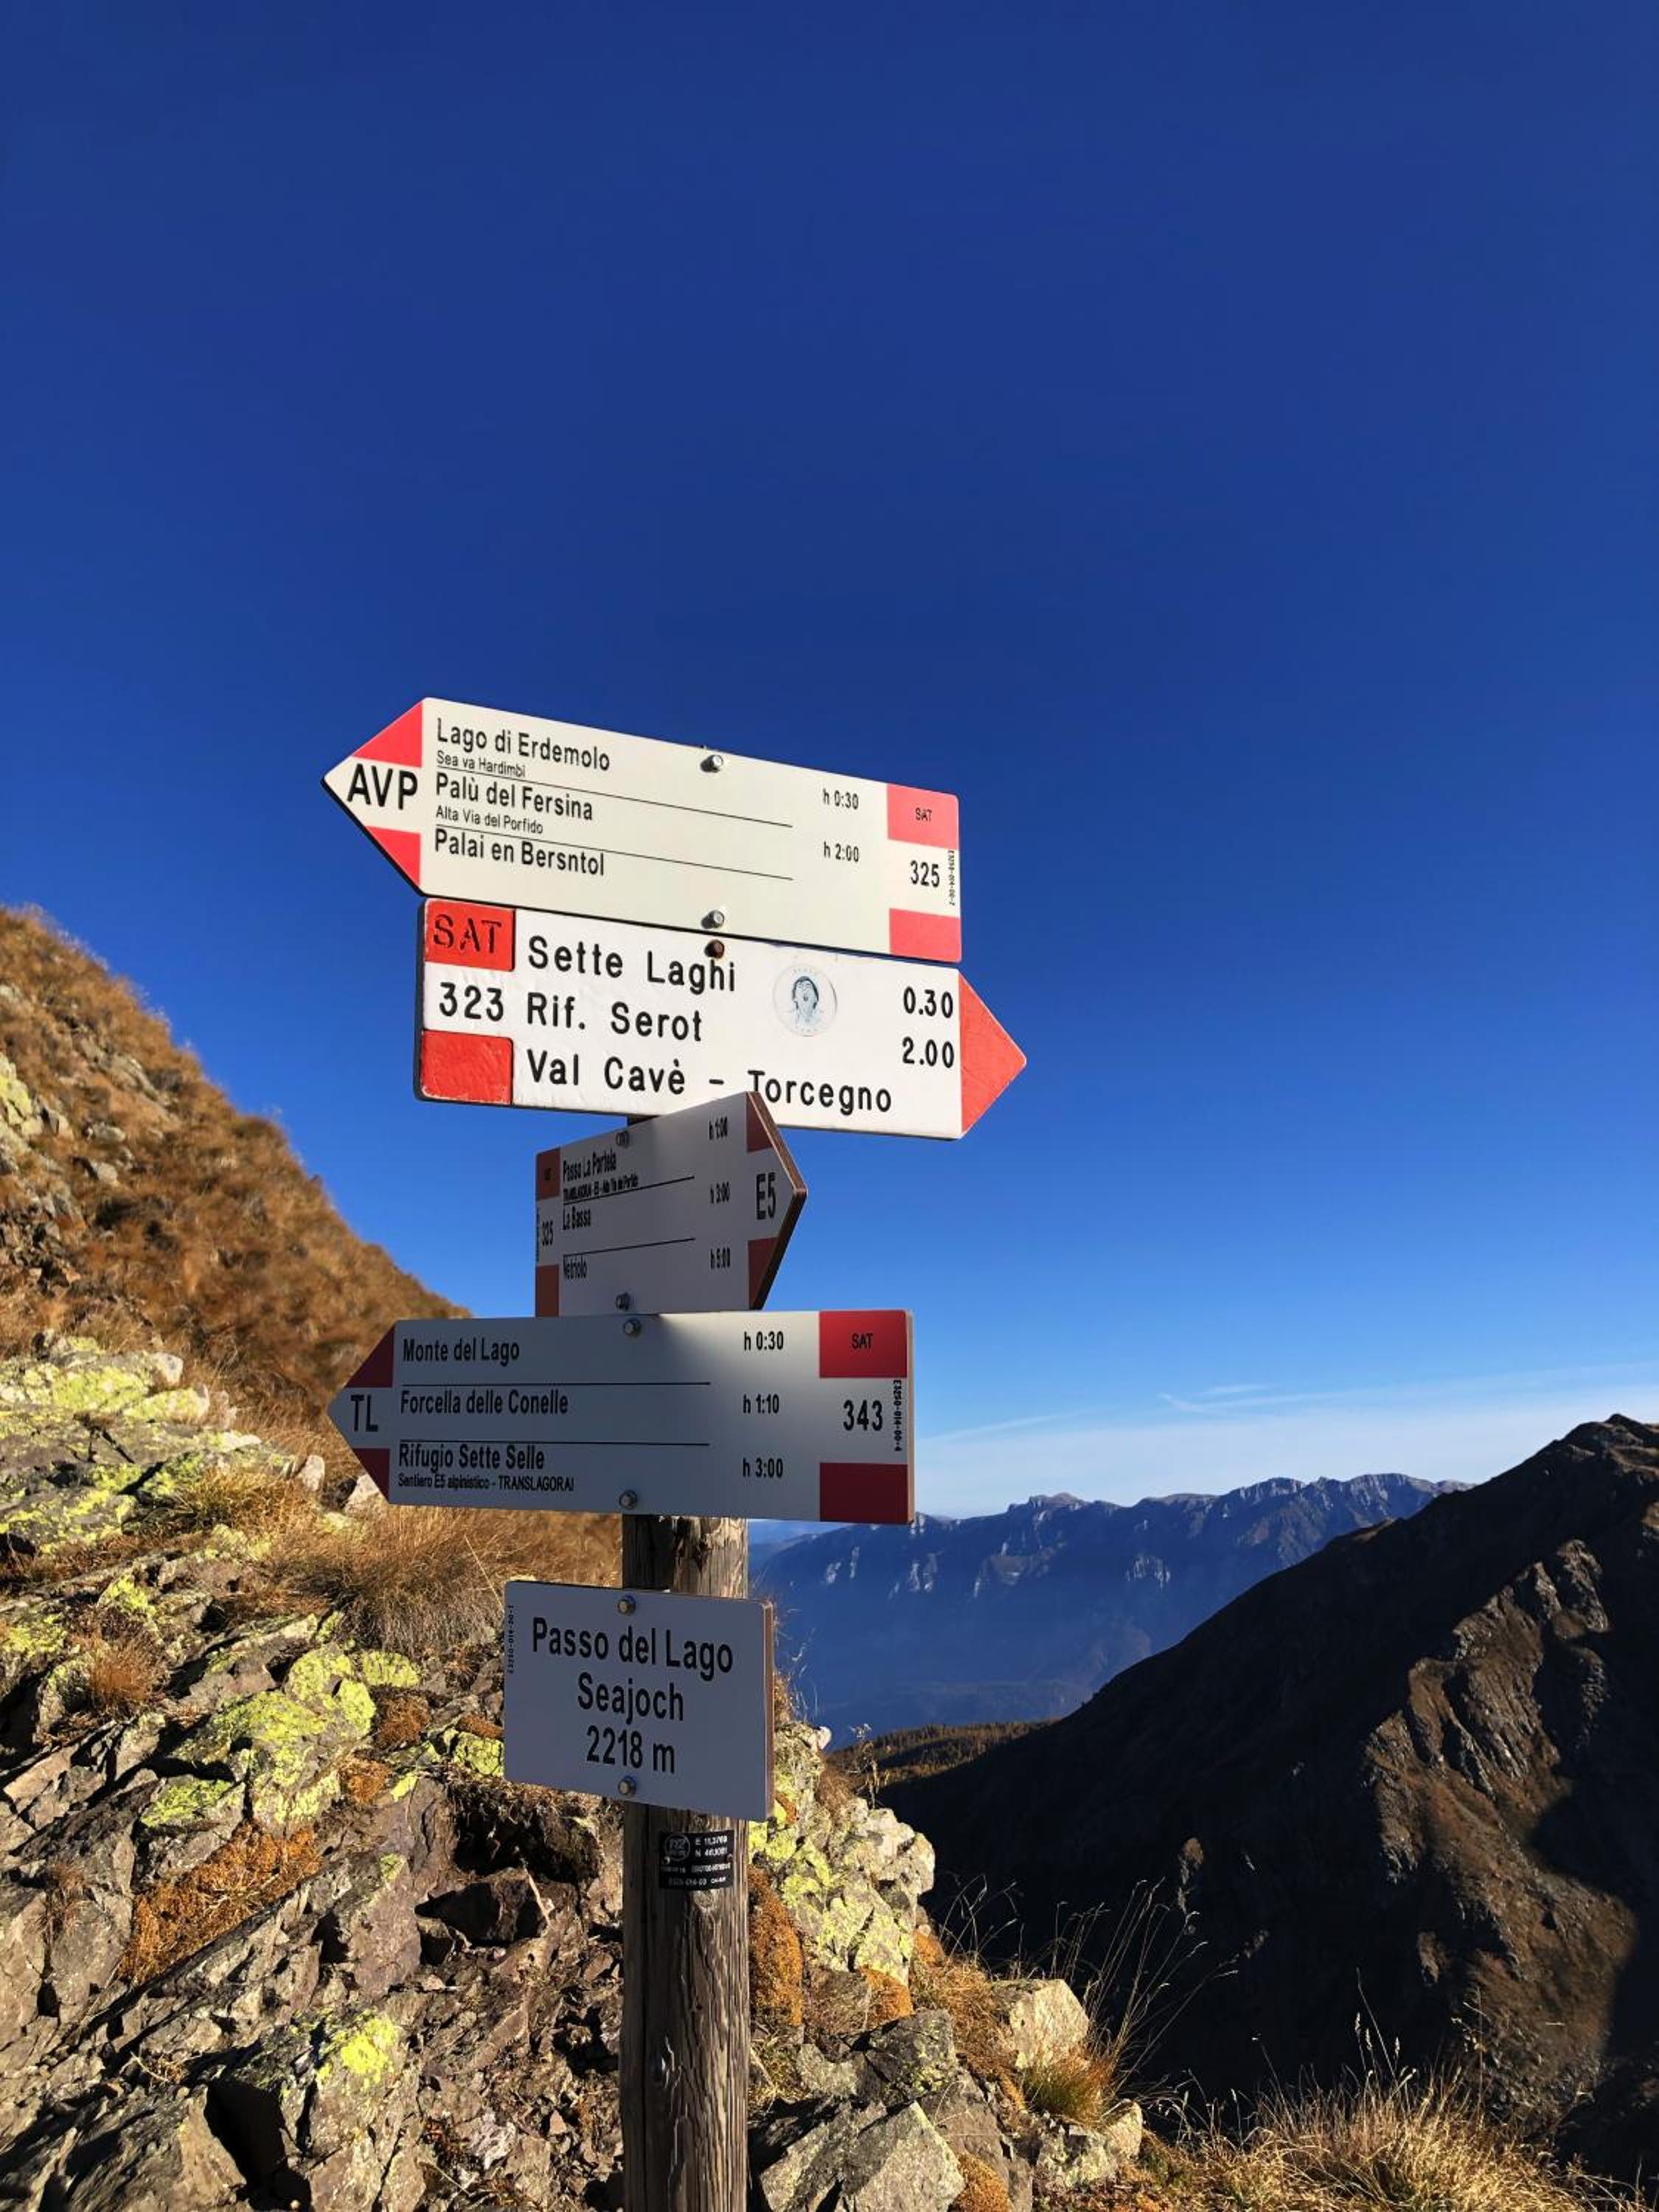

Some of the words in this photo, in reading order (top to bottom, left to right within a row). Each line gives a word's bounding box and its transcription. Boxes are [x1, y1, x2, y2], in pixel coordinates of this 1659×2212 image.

[437, 717, 487, 753] Lago
[495, 729, 511, 754] di
[518, 733, 610, 771] Erdemolo
[437, 751, 458, 767] Sea
[462, 757, 475, 769] va
[479, 758, 526, 777] Hardimbi
[347, 763, 417, 810] AVP
[436, 772, 479, 802] Palù
[487, 784, 515, 807] del
[522, 787, 593, 820] Fersina
[823, 788, 830, 804] h
[834, 790, 859, 810] 0:30
[436, 805, 459, 822] Alta
[462, 809, 481, 825] Via
[484, 813, 501, 827] del
[504, 815, 543, 834] Porfido
[915, 808, 932, 822] SAT
[435, 829, 484, 858] Palai
[492, 841, 515, 863] en
[522, 841, 605, 876] Bersntol
[824, 841, 830, 858] h
[835, 844, 859, 863] 2:00
[911, 860, 939, 887] 325
[433, 914, 501, 955] SAT
[529, 936, 623, 978] Sette
[647, 950, 736, 995] Laghi
[439, 981, 504, 1022] 323
[528, 992, 586, 1030] Rif.
[611, 1001, 702, 1041] Serot
[903, 987, 953, 1018] 0.30
[902, 1037, 954, 1068] 2.00
[526, 1048, 579, 1085] Val
[605, 1056, 686, 1094] Cavè
[748, 1070, 891, 1116] Torcegno
[563, 1158, 582, 1181] Passo
[756, 1172, 776, 1220] E5
[563, 1208, 571, 1231] La
[572, 1207, 591, 1228] Bassa
[403, 1338, 448, 1362] Monte
[453, 1338, 476, 1361] del
[481, 1339, 520, 1366] Lago
[744, 1332, 751, 1351] h
[756, 1331, 784, 1351] 0:30
[852, 1333, 873, 1350] SAT
[350, 1395, 378, 1433] TL
[400, 1389, 461, 1414] Forcella
[466, 1389, 503, 1414] delle
[509, 1389, 568, 1414] Conelle
[743, 1395, 751, 1414] h
[756, 1394, 779, 1414] 1:10
[843, 1399, 883, 1432] 343
[399, 1443, 453, 1473] Rifugio
[459, 1444, 501, 1469] Sette
[506, 1445, 544, 1470] Selle
[742, 1458, 751, 1478] h
[755, 1458, 784, 1478] 3:00
[398, 1472, 433, 1489] Sentiero
[498, 1476, 574, 1492] TRANSLAGORAI
[532, 1617, 610, 1660] Passo
[619, 1625, 656, 1664] del
[666, 1629, 734, 1682] Lago
[578, 1672, 684, 1725] Seajoch
[586, 1725, 644, 1769] 2218
[653, 1742, 675, 1774] m
